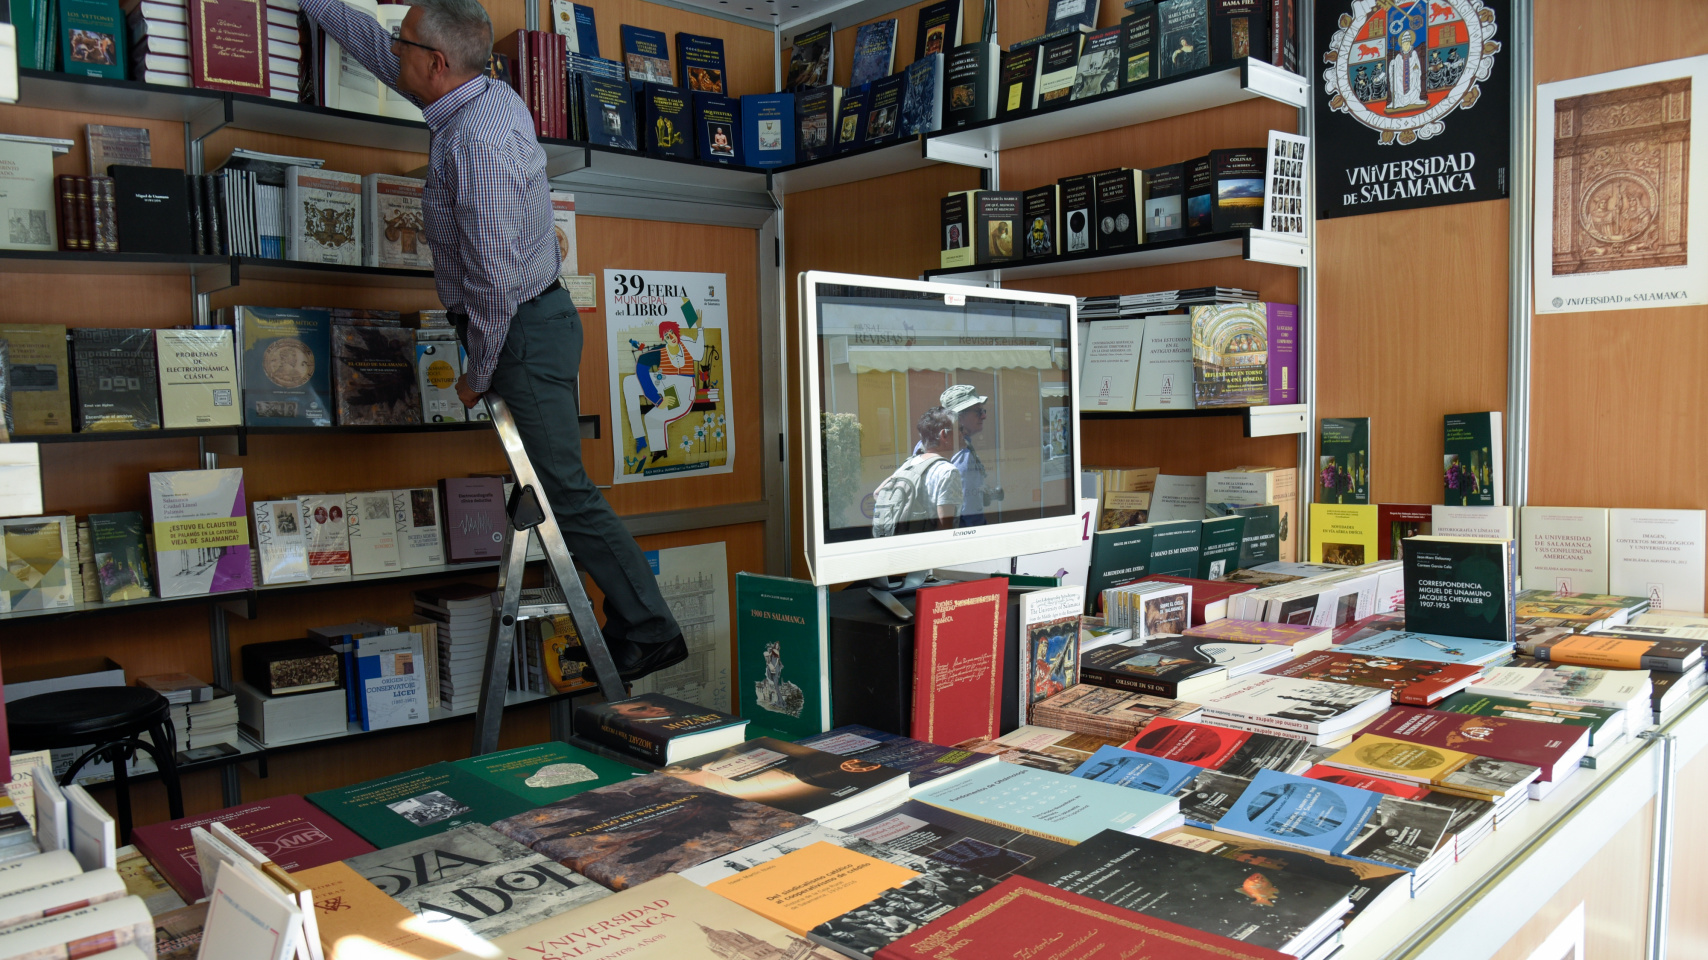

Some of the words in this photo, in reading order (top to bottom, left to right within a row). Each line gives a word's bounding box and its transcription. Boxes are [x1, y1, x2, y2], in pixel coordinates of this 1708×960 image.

[1343, 194, 1358, 206] DE
[1361, 172, 1476, 203] SALAMANCA
[614, 274, 645, 296] 39
[647, 284, 688, 298] FERIA
[614, 296, 667, 305] MUNICIPAL
[1633, 290, 1688, 302] SALAMANCA
[626, 304, 668, 316] LIBRO
[854, 331, 903, 344] REVISTAS
[166, 365, 229, 373] ELECTRODINÁMICA
[184, 372, 214, 380] CLÁSICA
[170, 524, 196, 532] ¿ESTUVO
[953, 528, 976, 537] lenovo
[201, 535, 239, 543] SALAMANCA?
[1103, 569, 1125, 577] ALREDEDOR
[1418, 579, 1482, 589] CORRESPONDENCIA
[1419, 587, 1443, 595] MIGUEL
[1454, 589, 1492, 598] UNAMUNO
[1650, 588, 1660, 598] A
[1419, 594, 1447, 603] JACQUES
[1449, 596, 1483, 605] CHEVALIER
[1419, 601, 1451, 610] 1907-1935
[1038, 604, 1057, 614] University
[1063, 602, 1081, 610] Salamanca
[751, 609, 762, 617] 1900
[772, 612, 805, 624] SALAMANCA
[366, 682, 416, 694] CONSERVATORI
[1115, 679, 1138, 687] ROSTRO
[393, 689, 416, 698] LICEU
[662, 714, 721, 731] MOZART
[1256, 715, 1273, 724] ajedrez
[1284, 720, 1302, 728] camino
[1254, 726, 1272, 735] ajedrez
[709, 760, 733, 773] Leer
[736, 757, 745, 765] el
[748, 750, 768, 761] cine
[949, 787, 987, 802] Fundamentos
[587, 819, 619, 832] CIELO
[621, 813, 636, 821] DE
[637, 794, 699, 815] SALAMANCA
[646, 805, 685, 820] SALAMANCA
[250, 817, 305, 835] COMERCIAL
[984, 817, 1020, 832] OFTALMOLOGÍA
[1030, 829, 1070, 845] FUNDAMENTOS
[1079, 865, 1103, 883] PROVINCIA
[1110, 847, 1141, 865] SALAMANCA
[781, 876, 825, 896] sindicalismo
[826, 863, 853, 877] católico
[783, 877, 837, 903] cooperativismo
[847, 862, 871, 874] crédito
[1048, 878, 1061, 887] LOS
[1061, 869, 1082, 882] PECES
[525, 899, 671, 954] VNIVERSIDAD
[541, 912, 677, 960] SALAMANCA
